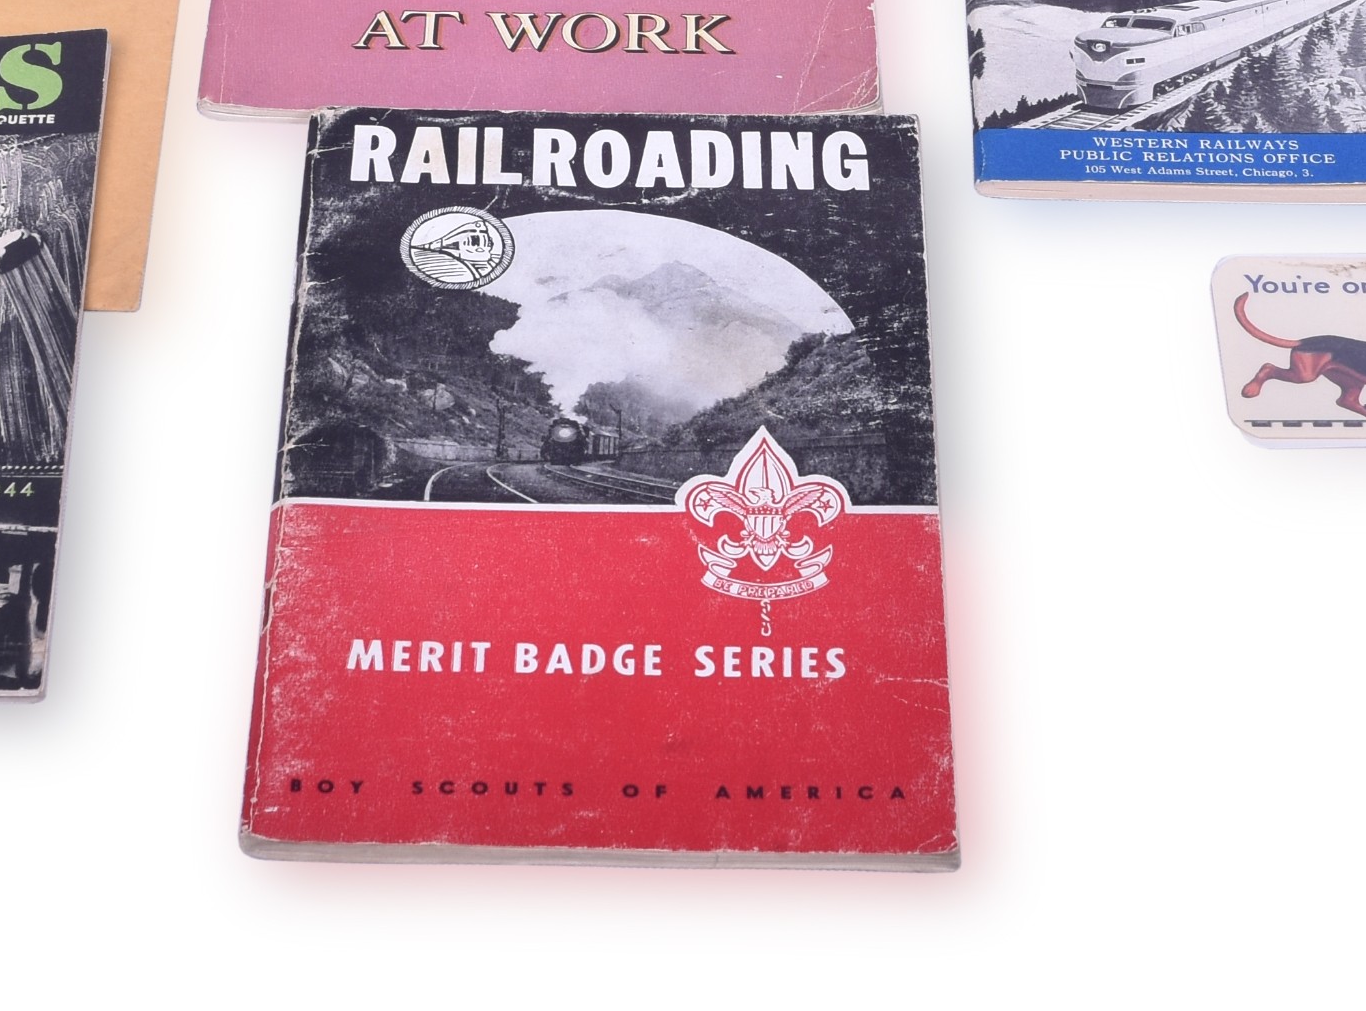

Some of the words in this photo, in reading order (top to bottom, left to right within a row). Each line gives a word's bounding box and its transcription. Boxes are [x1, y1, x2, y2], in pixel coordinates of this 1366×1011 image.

[352, 10, 465, 50] AT
[485, 12, 736, 54] WORK
[1092, 137, 1188, 148] WESTERN
[1199, 140, 1299, 150] RAILWAYS
[350, 125, 871, 192] RAILROADING
[1059, 150, 1133, 160] PUBLIC
[1142, 152, 1255, 163] RELATIONS
[1263, 154, 1336, 163] OFFICE
[1244, 275, 1330, 293] You're
[347, 639, 491, 672] MERIT
[515, 643, 661, 675] BADGE
[695, 646, 845, 681] SERIES
[290, 778, 363, 794] BOY
[412, 781, 573, 796] SCOUTS
[622, 784, 667, 798] OF
[716, 785, 905, 800] AMERICA
